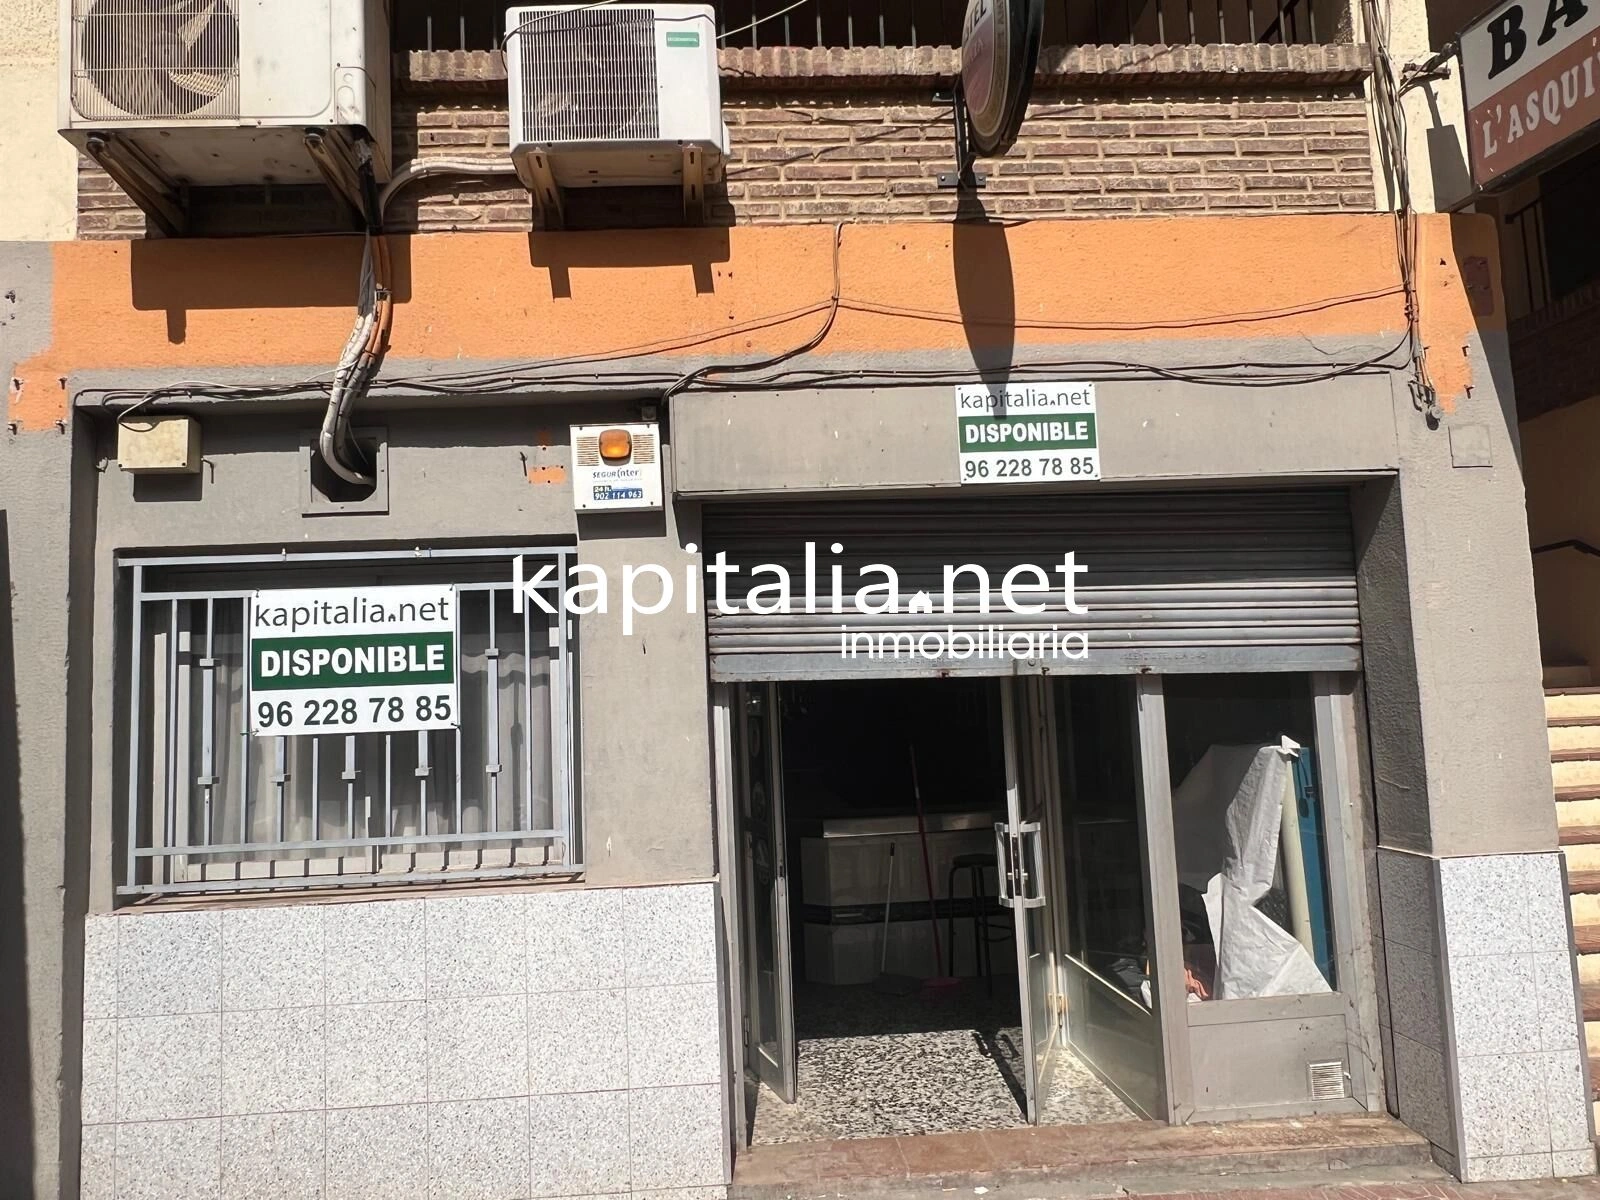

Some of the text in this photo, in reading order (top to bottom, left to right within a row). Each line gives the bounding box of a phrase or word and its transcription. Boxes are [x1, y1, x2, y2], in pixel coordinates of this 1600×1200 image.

[1482, 51, 1600, 159] L'ASQUI
[960, 388, 1091, 412] kapitalia.net
[965, 421, 1089, 444] DISPONIBLE
[965, 457, 1094, 478] 96 228 78 85
[595, 490, 642, 500] 902 114 963
[255, 596, 449, 633] kapitalia.net
[261, 644, 445, 678] DISPONIBLE
[258, 695, 451, 728] 96 228 78 85
